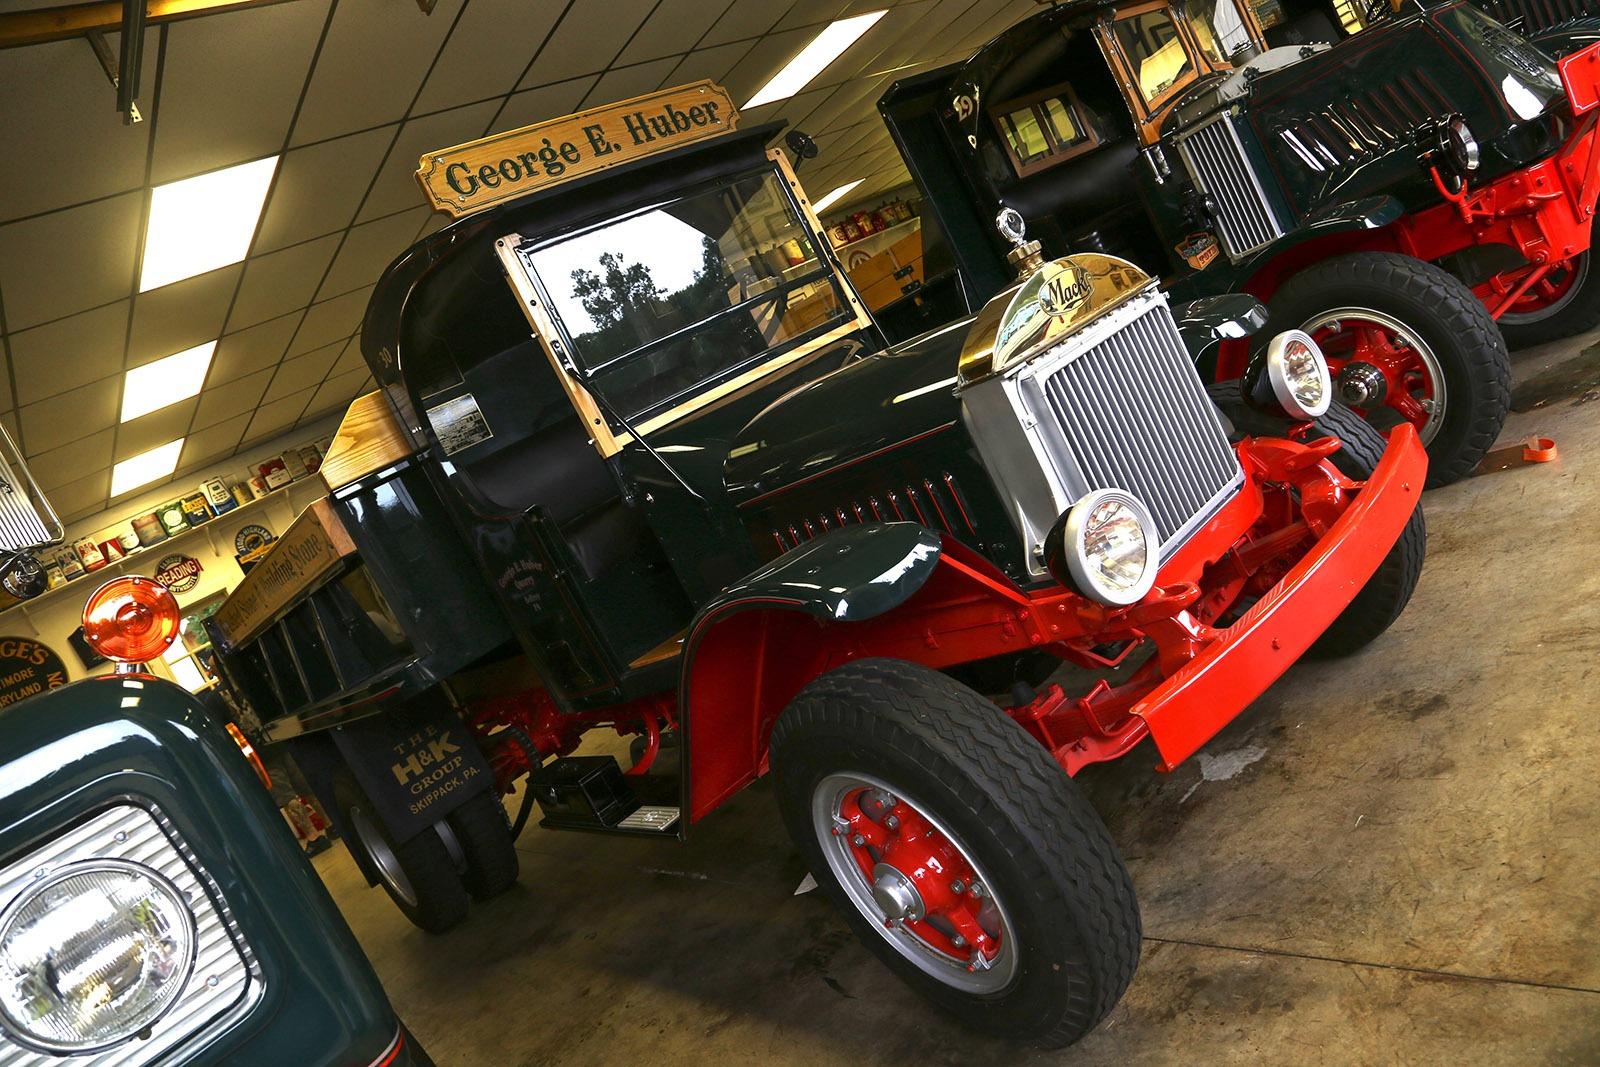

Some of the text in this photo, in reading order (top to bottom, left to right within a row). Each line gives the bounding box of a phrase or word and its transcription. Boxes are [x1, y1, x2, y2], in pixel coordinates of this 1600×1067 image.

[445, 99, 720, 197] George E. Huber
[1047, 268, 1093, 306] Mack
[288, 534, 323, 571] Stone
[156, 560, 198, 586] READING
[0, 640, 49, 665] GE'S
[393, 725, 437, 754] THE
[391, 731, 462, 786] H&K
[410, 755, 464, 796] GROUP
[462, 766, 481, 784] PA.
